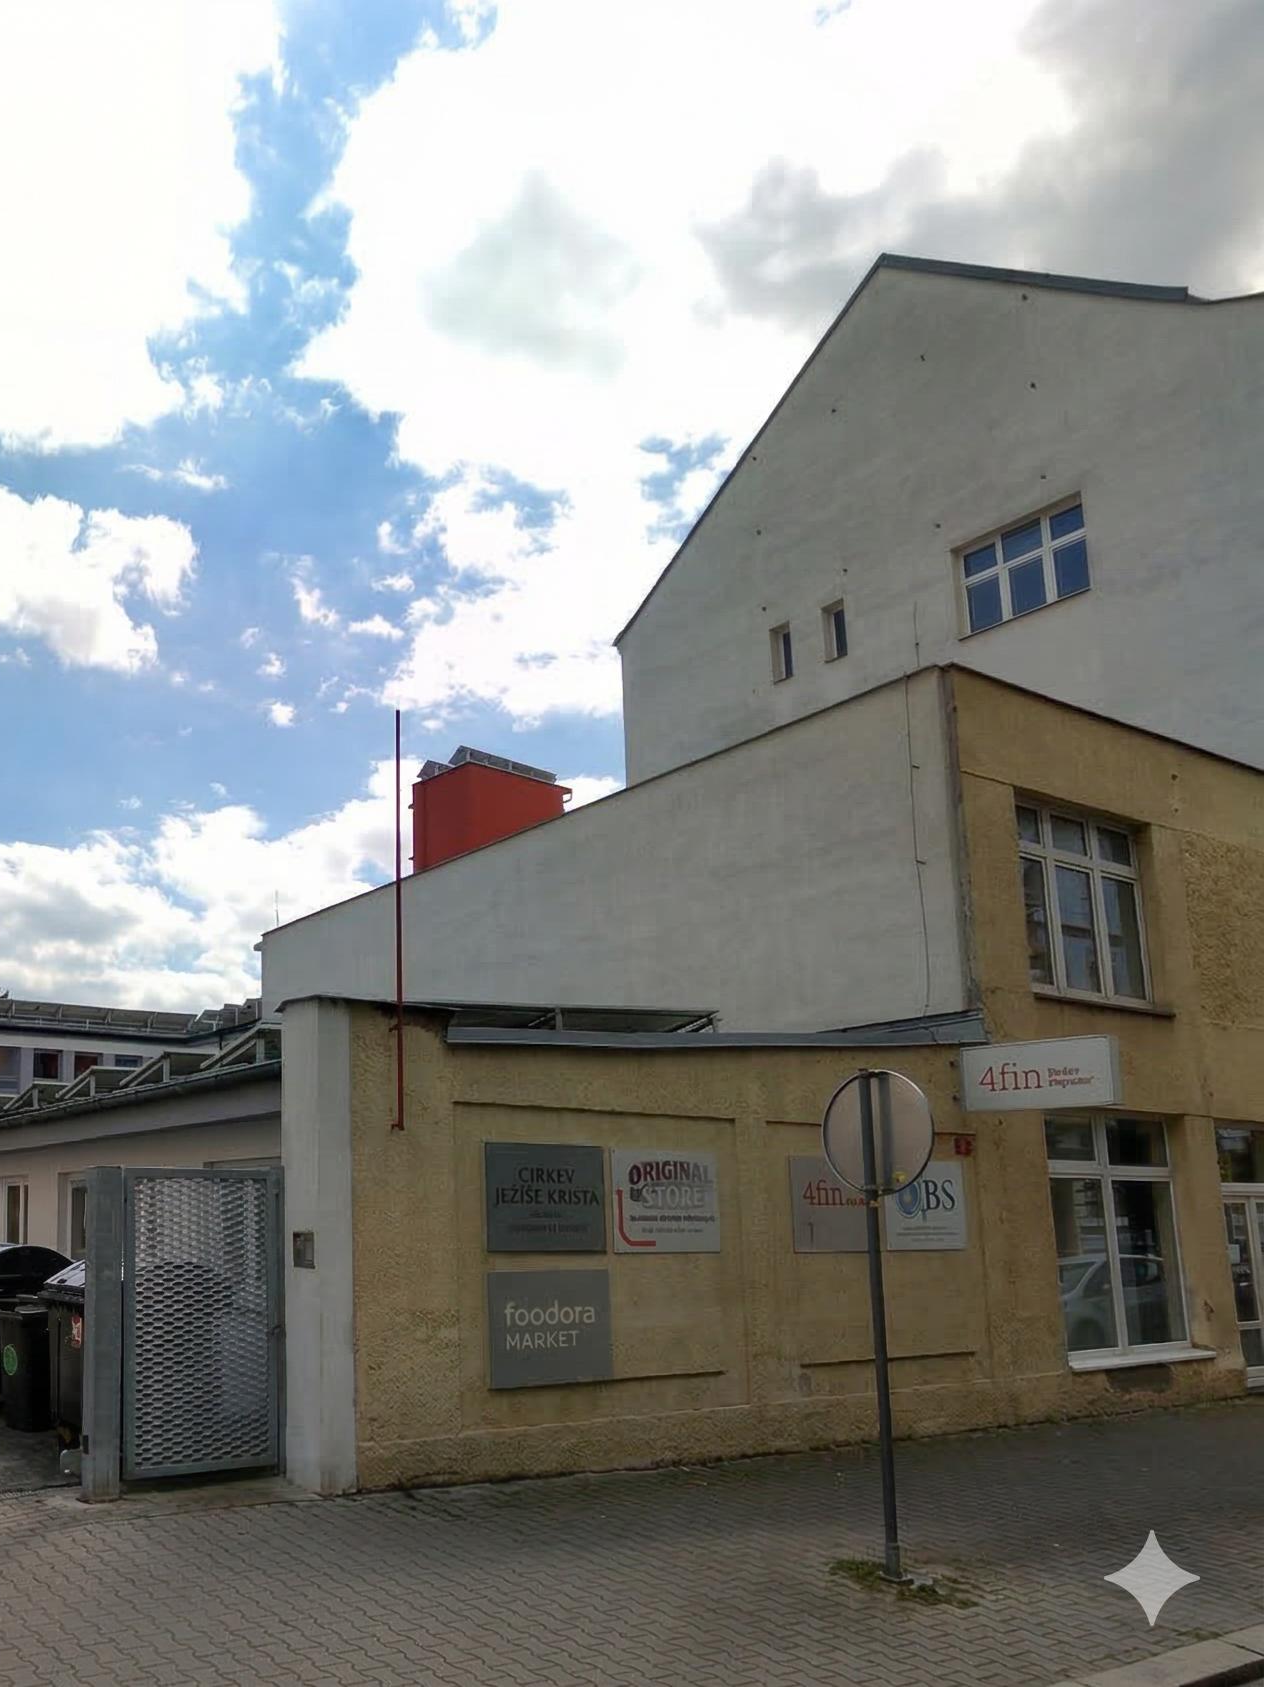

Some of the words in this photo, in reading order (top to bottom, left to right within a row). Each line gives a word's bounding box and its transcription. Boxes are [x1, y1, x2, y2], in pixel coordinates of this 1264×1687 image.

[978, 1063, 1044, 1093] 4fin
[628, 1160, 714, 1185] ORIGINAL
[548, 1188, 600, 1205] KRISTA
[641, 1184, 704, 1208] STORE
[504, 1299, 596, 1326] foodora
[506, 1330, 580, 1350] MARKET
